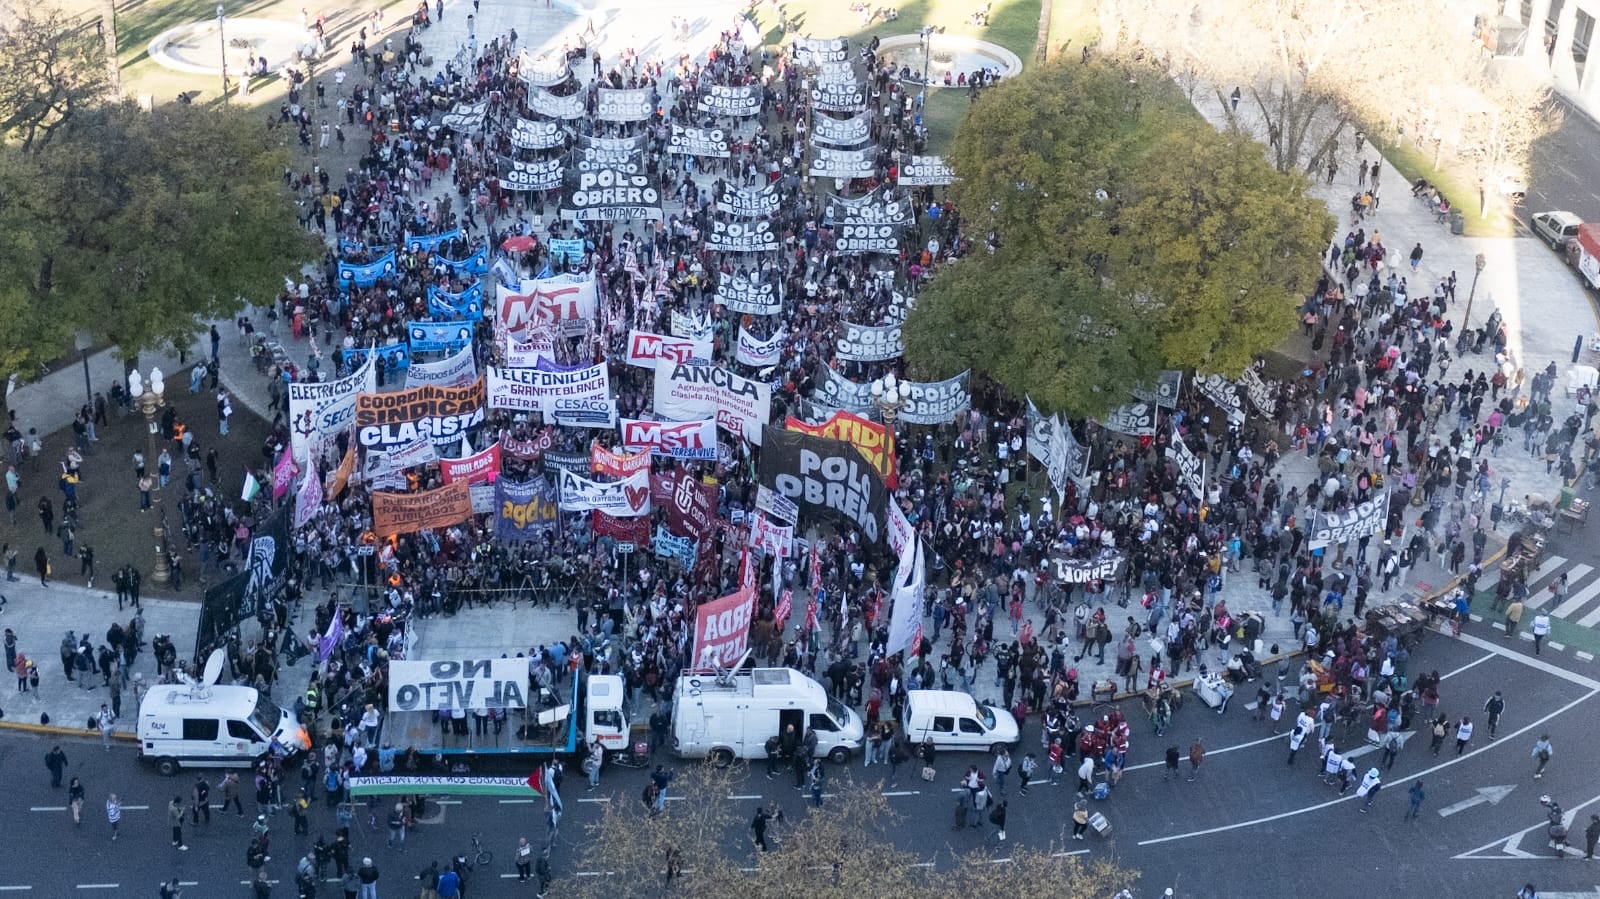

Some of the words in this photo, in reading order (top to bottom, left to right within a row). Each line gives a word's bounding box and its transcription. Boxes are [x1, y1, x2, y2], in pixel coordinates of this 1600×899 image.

[604, 92, 645, 104] POLO
[711, 86, 751, 98] POLO
[811, 90, 862, 105] OBRERO
[598, 102, 651, 114] OBRERO
[704, 95, 755, 108] OBRERO
[672, 124, 723, 142] POLO
[816, 125, 867, 140] OBRERO
[823, 118, 864, 131] POLO
[511, 128, 562, 145] OBRERO
[670, 135, 728, 151] OBRERO
[813, 158, 872, 171] OBRERO
[820, 149, 864, 163] POLO
[912, 155, 944, 166] POL
[513, 159, 560, 174] POLO
[581, 169, 648, 191] POLO
[572, 187, 658, 207] OBRERO
[725, 182, 775, 199] POLO
[723, 193, 779, 209] OBRERO
[576, 210, 589, 220] LA
[598, 207, 647, 220] MATANZA
[846, 202, 900, 219] POLO
[713, 221, 770, 237] POLO
[843, 226, 893, 238] POLO
[836, 237, 898, 250] OBRERO
[718, 286, 775, 305] OBRERO
[506, 293, 579, 328] MST
[847, 327, 902, 345] POLO
[636, 338, 693, 364] MST
[408, 370, 448, 381] DESPIDOS
[493, 365, 600, 386] TELEFONICOS
[670, 364, 759, 401] ANCLA
[291, 377, 353, 400] ELECTRICOS
[359, 380, 484, 408] COORDINADORA
[511, 383, 561, 397] GRANATE
[563, 377, 605, 395] BLANCA
[911, 382, 961, 402] POLO
[359, 407, 485, 446] CLASISTA
[718, 411, 743, 431] MST
[631, 426, 703, 450] MST
[671, 446, 697, 457] TERESA
[698, 446, 716, 457] VIVE
[801, 449, 871, 505] POLO
[375, 492, 468, 514] TRABAJADORES
[776, 473, 878, 544] OBRERO
[392, 504, 456, 522] JUBILADOS
